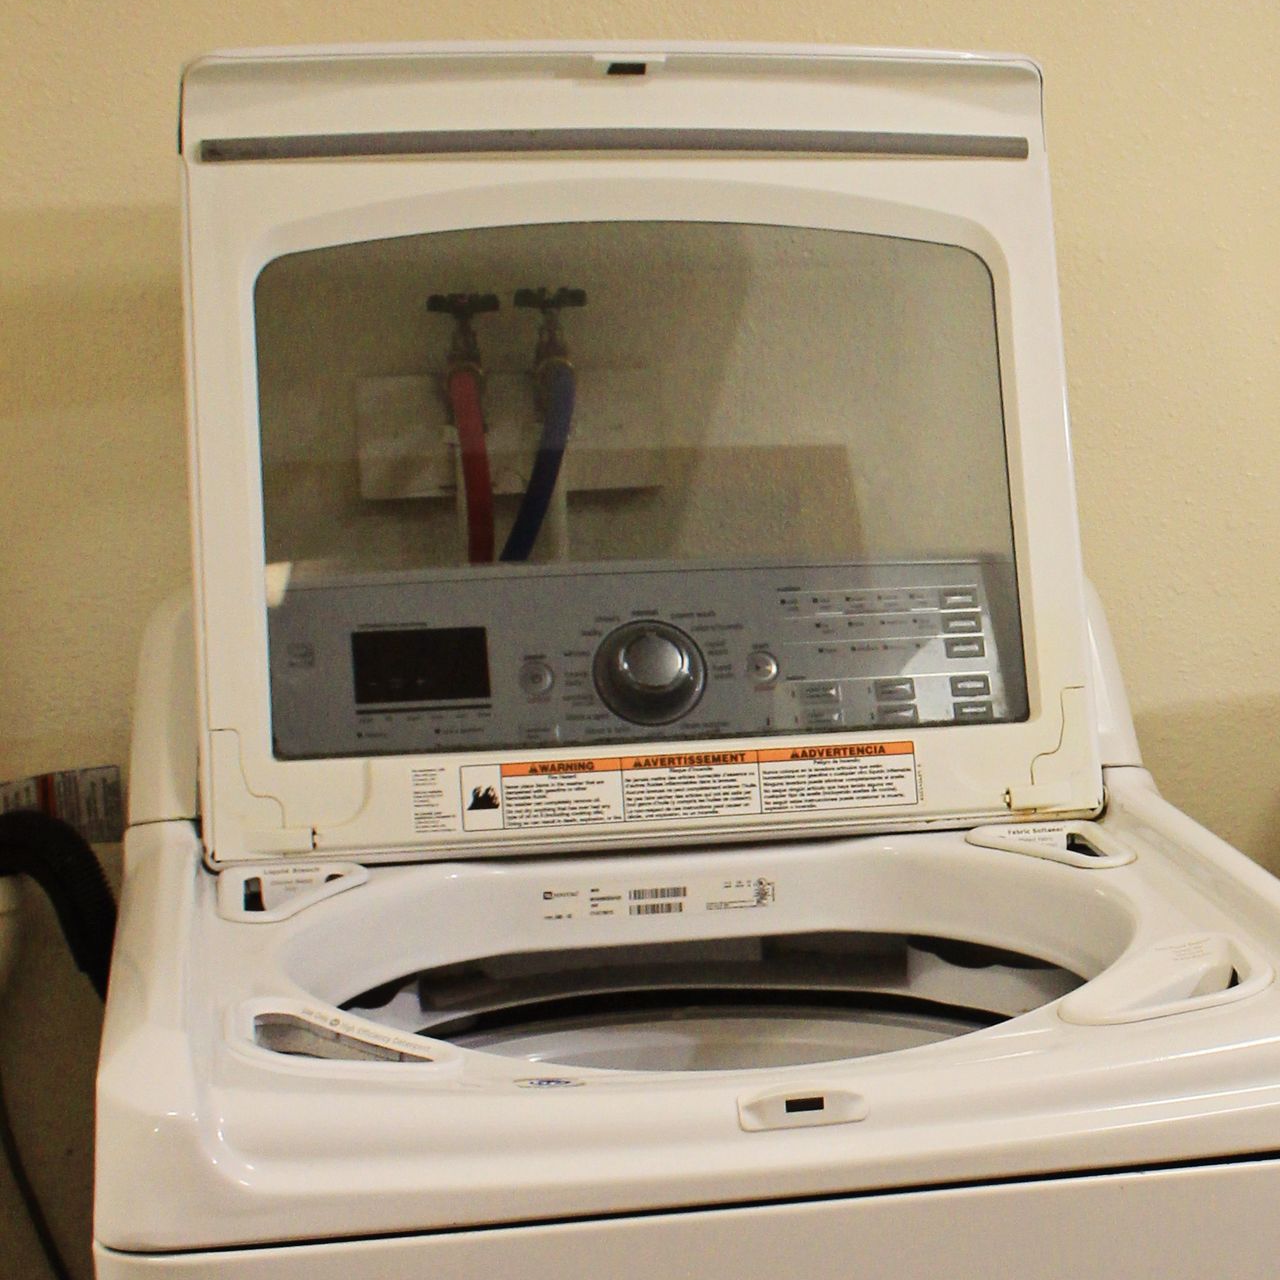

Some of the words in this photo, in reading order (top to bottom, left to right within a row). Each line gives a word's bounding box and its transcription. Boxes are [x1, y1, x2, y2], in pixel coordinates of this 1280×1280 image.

[801, 745, 886, 758] ADVERTENCIA
[540, 761, 594, 772] WARNING
[642, 753, 746, 767] AVERTISSEMENT
